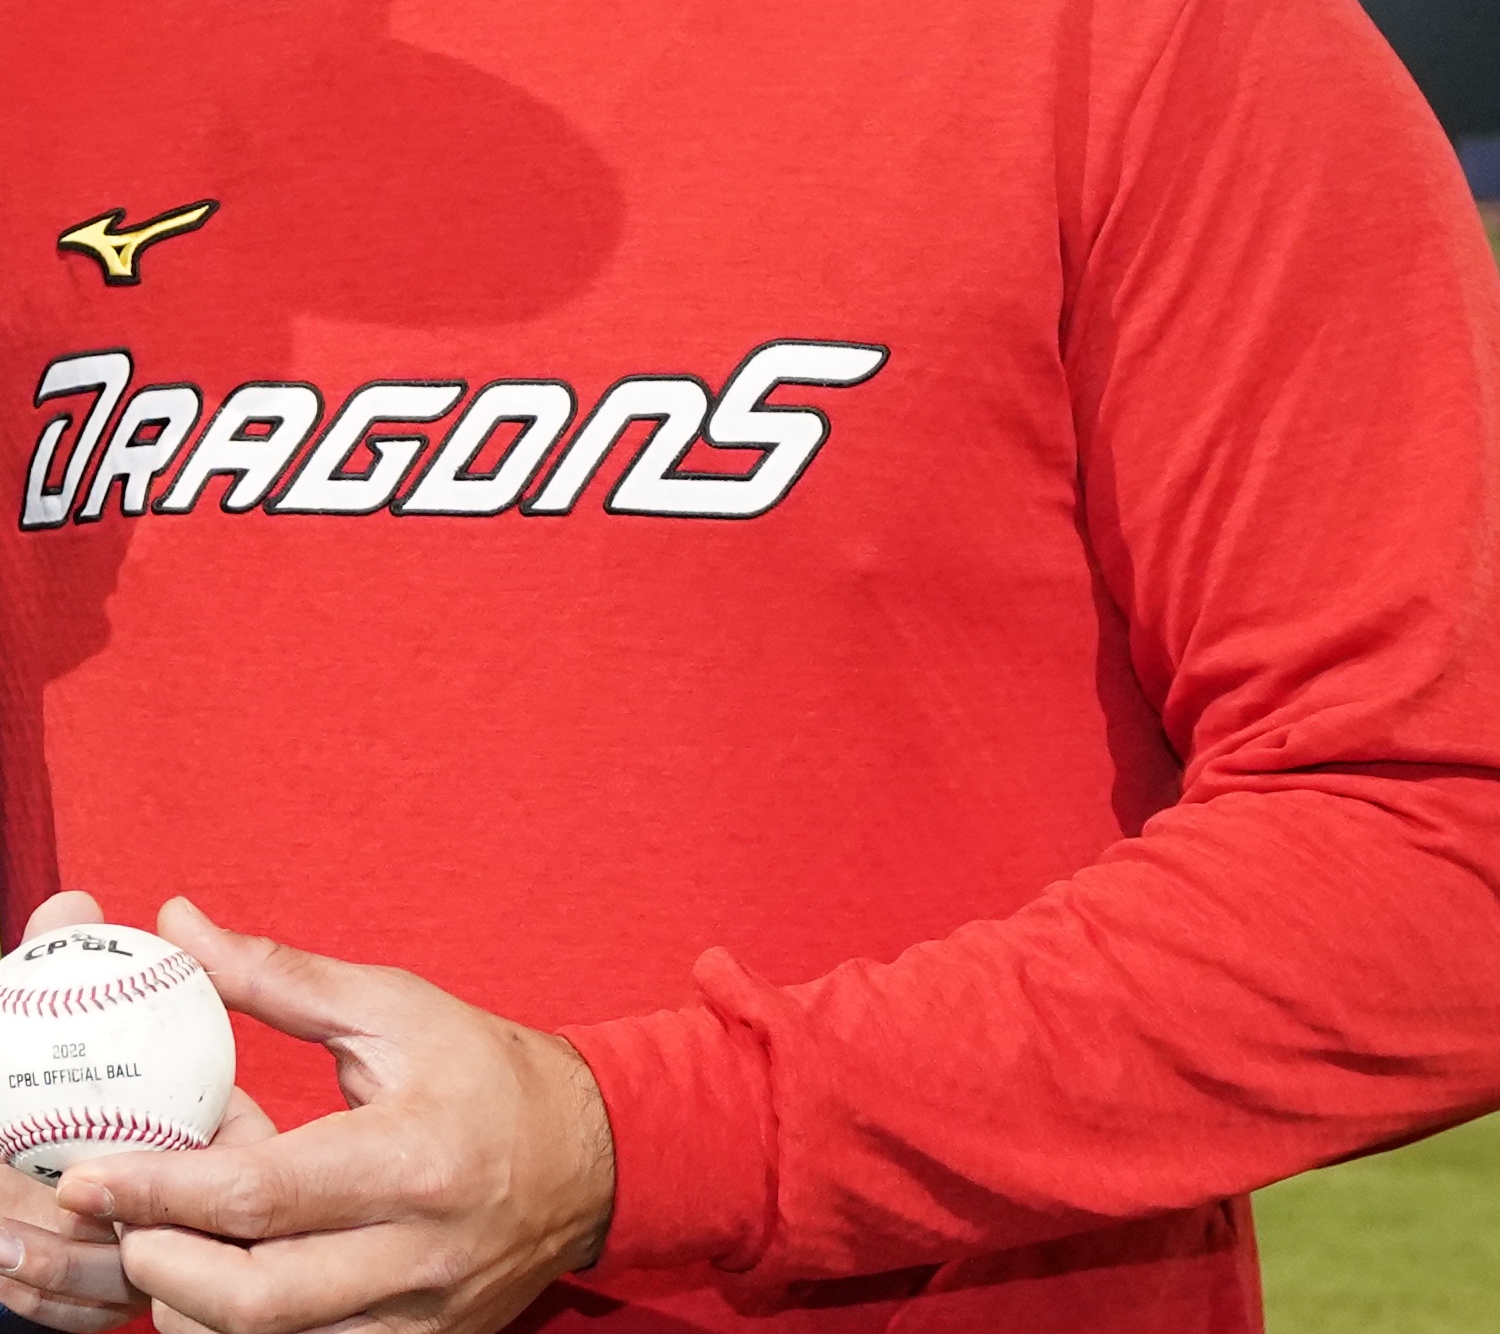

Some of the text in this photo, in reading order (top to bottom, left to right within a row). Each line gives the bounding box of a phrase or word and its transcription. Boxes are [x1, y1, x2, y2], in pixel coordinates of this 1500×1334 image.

[19, 338, 889, 531] DRAGONS
[24, 939, 133, 961] CPBL
[52, 1043, 86, 1059] 2022
[9, 1063, 142, 1089] CPBL OFFICIAL BALL
